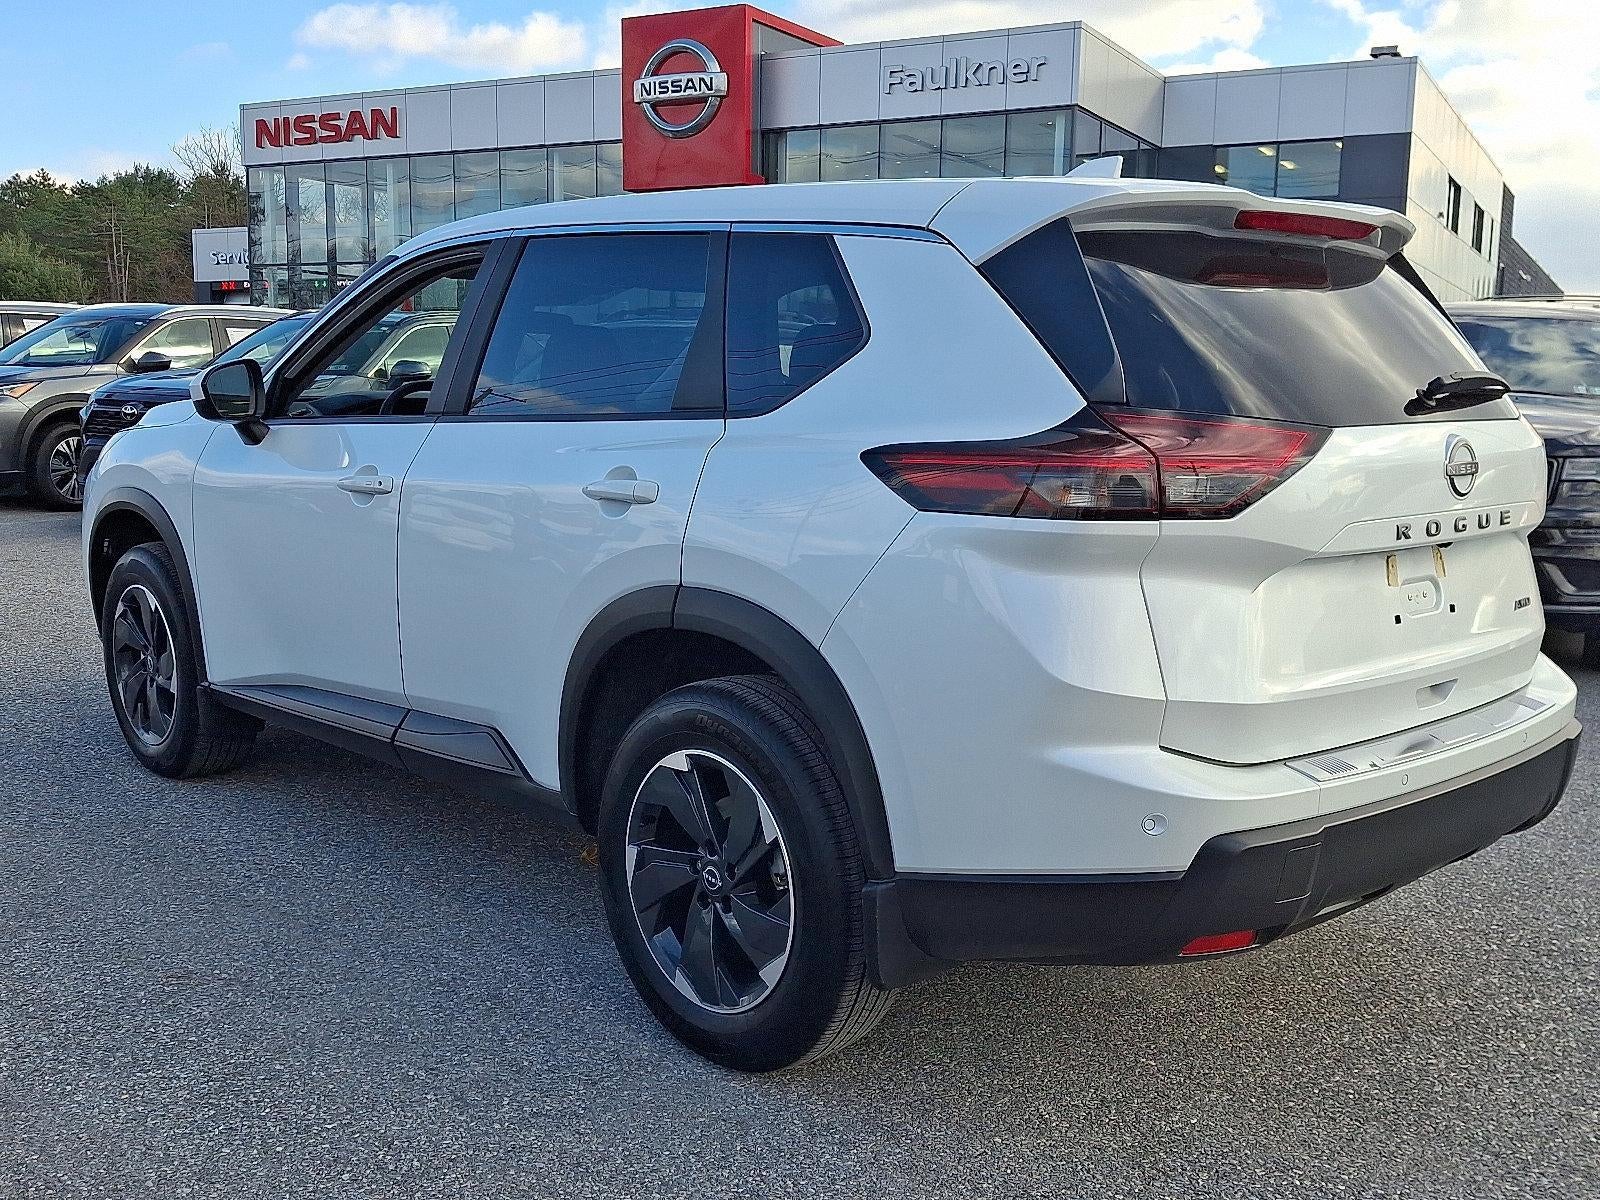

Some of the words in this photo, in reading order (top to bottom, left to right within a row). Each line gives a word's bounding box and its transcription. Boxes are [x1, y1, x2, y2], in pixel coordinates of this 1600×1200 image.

[639, 75, 714, 98] NISSAN
[883, 55, 1047, 95] Faulkner
[255, 106, 399, 149] NISSAN
[1395, 510, 1511, 541] ROGUE
